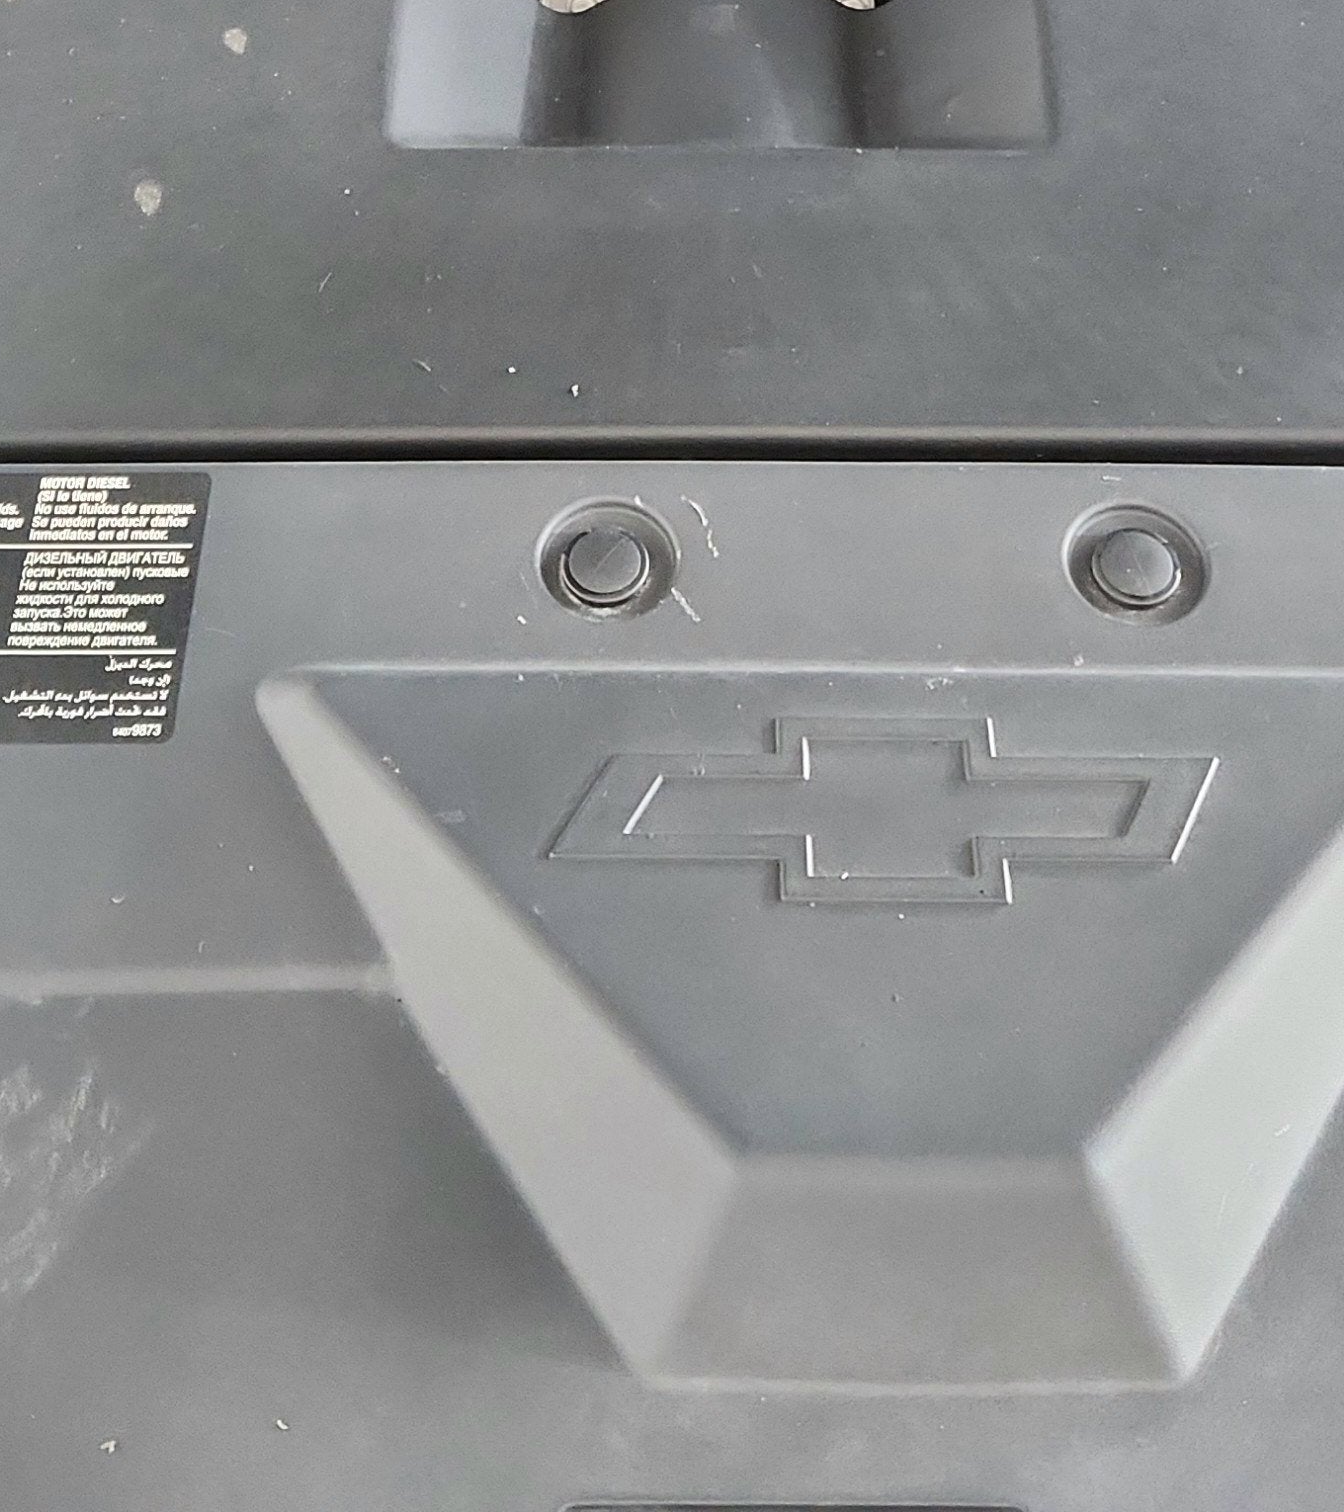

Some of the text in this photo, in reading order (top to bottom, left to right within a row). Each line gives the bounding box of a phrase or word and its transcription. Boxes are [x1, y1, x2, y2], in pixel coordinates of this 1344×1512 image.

[40, 477, 131, 489] MOTOR DIESEL
[37, 490, 108, 503] (Si lo tiene)
[34, 503, 197, 517] No use fluidos de arranque.
[31, 516, 189, 529] Se pueden producir daños
[98, 531, 115, 541] en
[116, 529, 129, 541] el
[130, 530, 168, 541] motor.
[23, 551, 186, 565] ДИЗЕЛЬНЫЙ ДВИГАТЕЛЬ
[21, 566, 189, 580] (если установлен) пусковые
[19, 580, 116, 593] Не используйте
[15, 594, 165, 606] жидкости для холодного
[89, 608, 128, 619] может
[10, 621, 147, 633] вызвать немедленное
[7, 635, 158, 648] повреждение двигателя.
